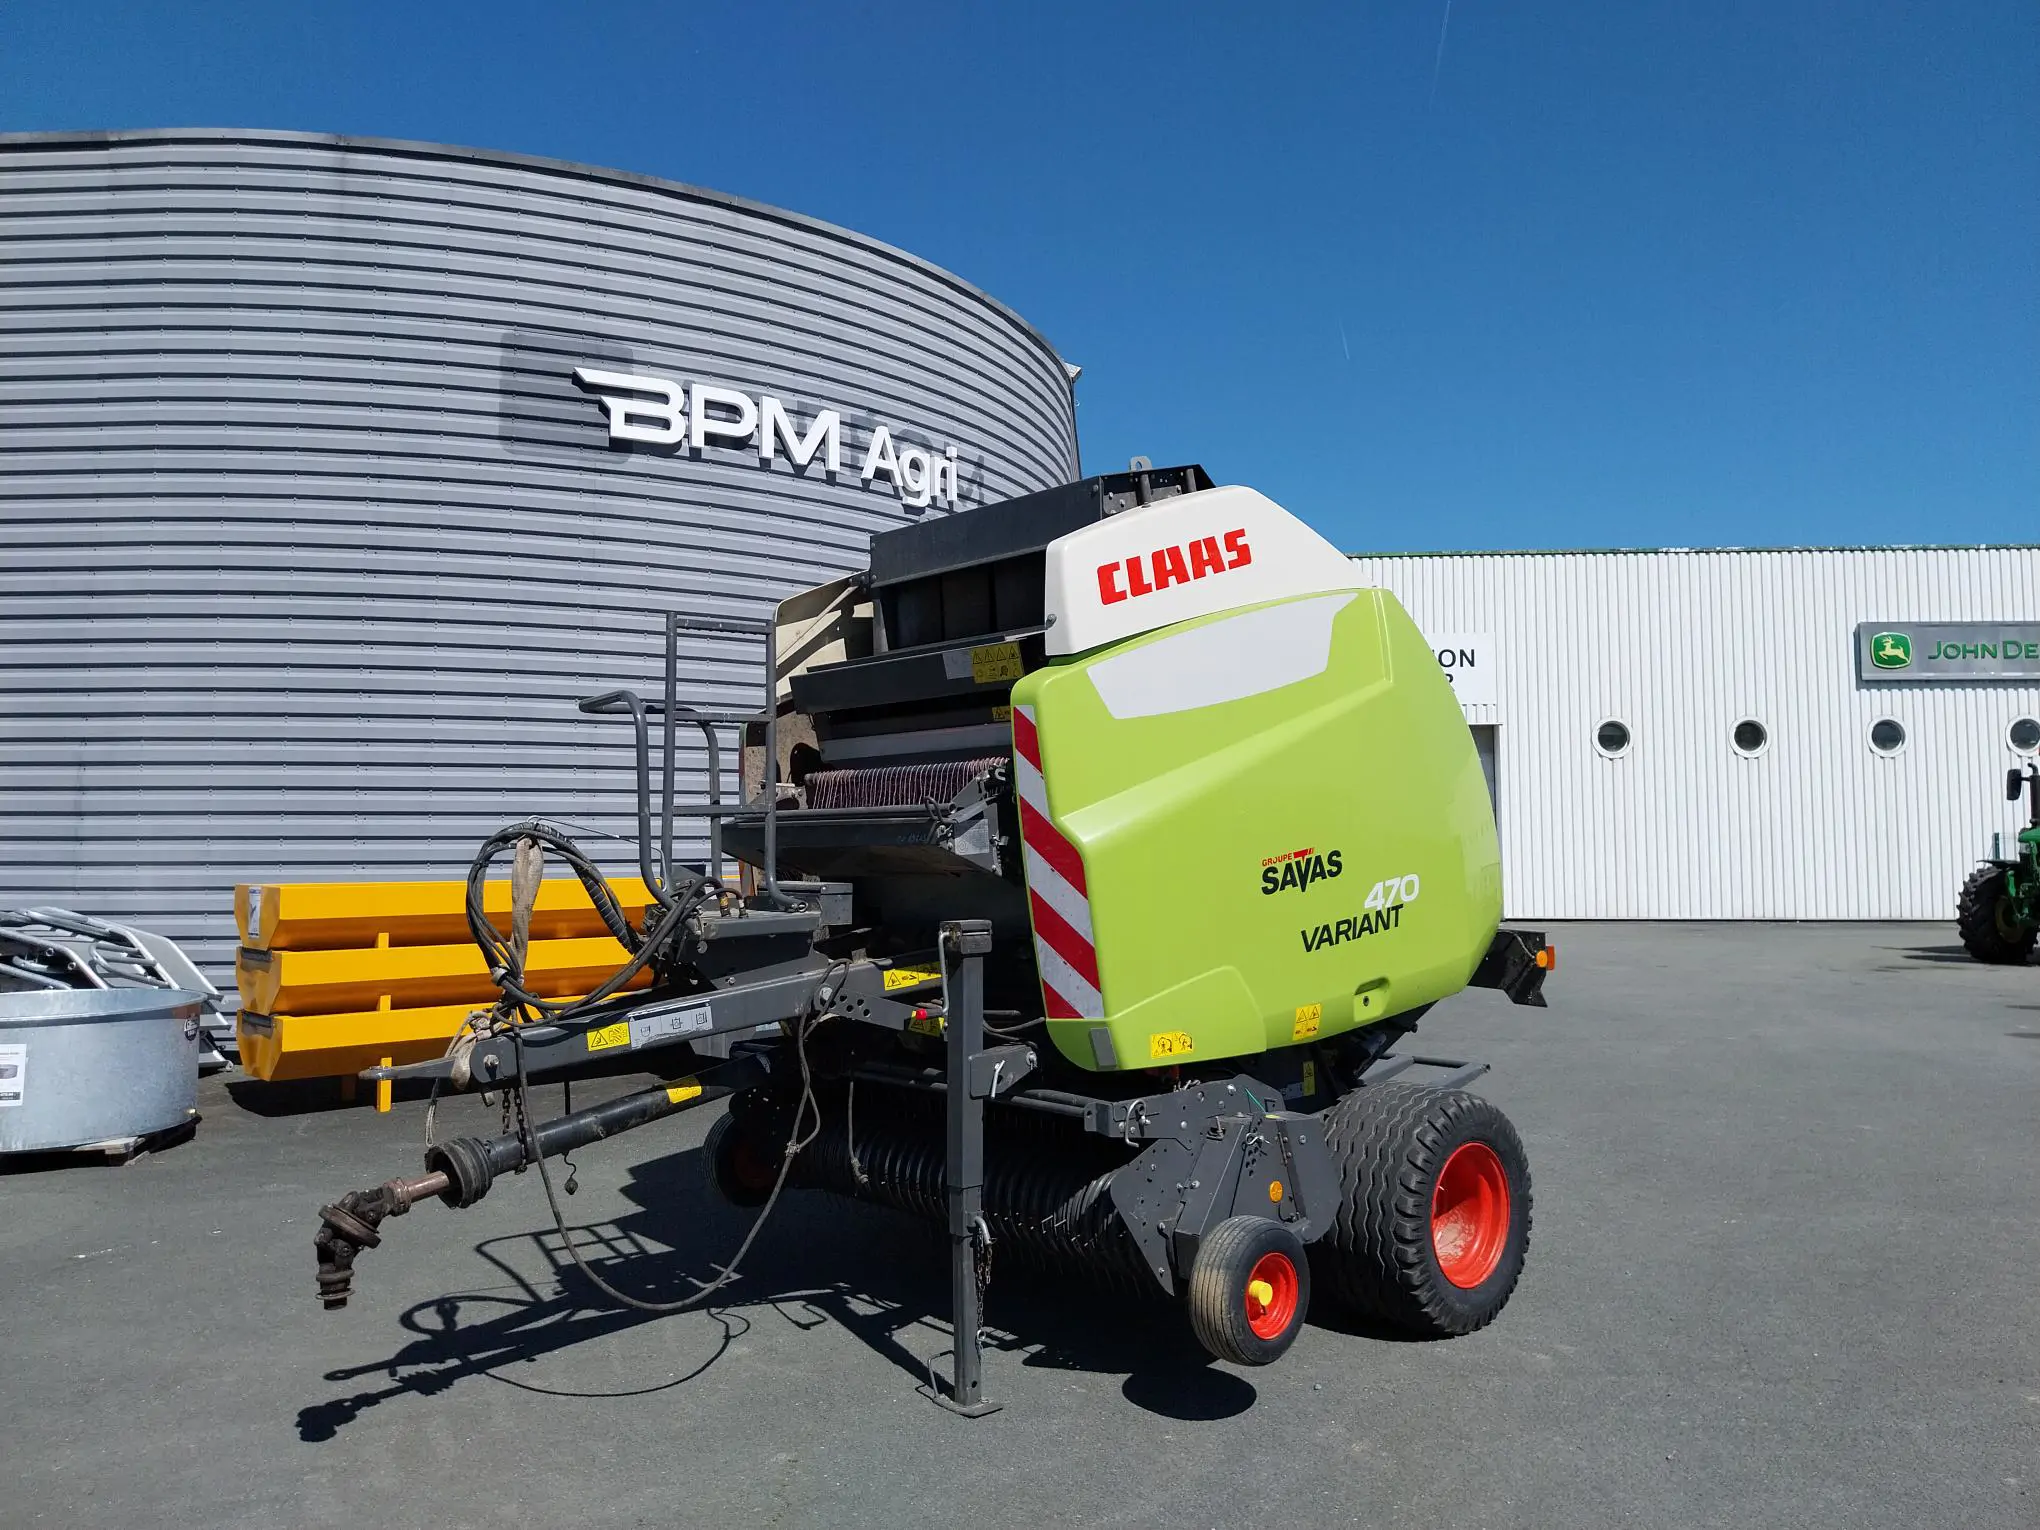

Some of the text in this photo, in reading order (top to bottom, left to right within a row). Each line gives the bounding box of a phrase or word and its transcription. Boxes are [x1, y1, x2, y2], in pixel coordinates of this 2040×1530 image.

[573, 366, 959, 508] BPM Agri
[1097, 528, 1252, 606] CLAAS
[1432, 648, 1476, 668] ON
[1928, 640, 1998, 660] JOHN
[1261, 852, 1293, 867] GROUPE
[1261, 849, 1343, 895] SAVAS
[1364, 873, 1420, 911] 470
[1301, 903, 1404, 953] VARIANT
